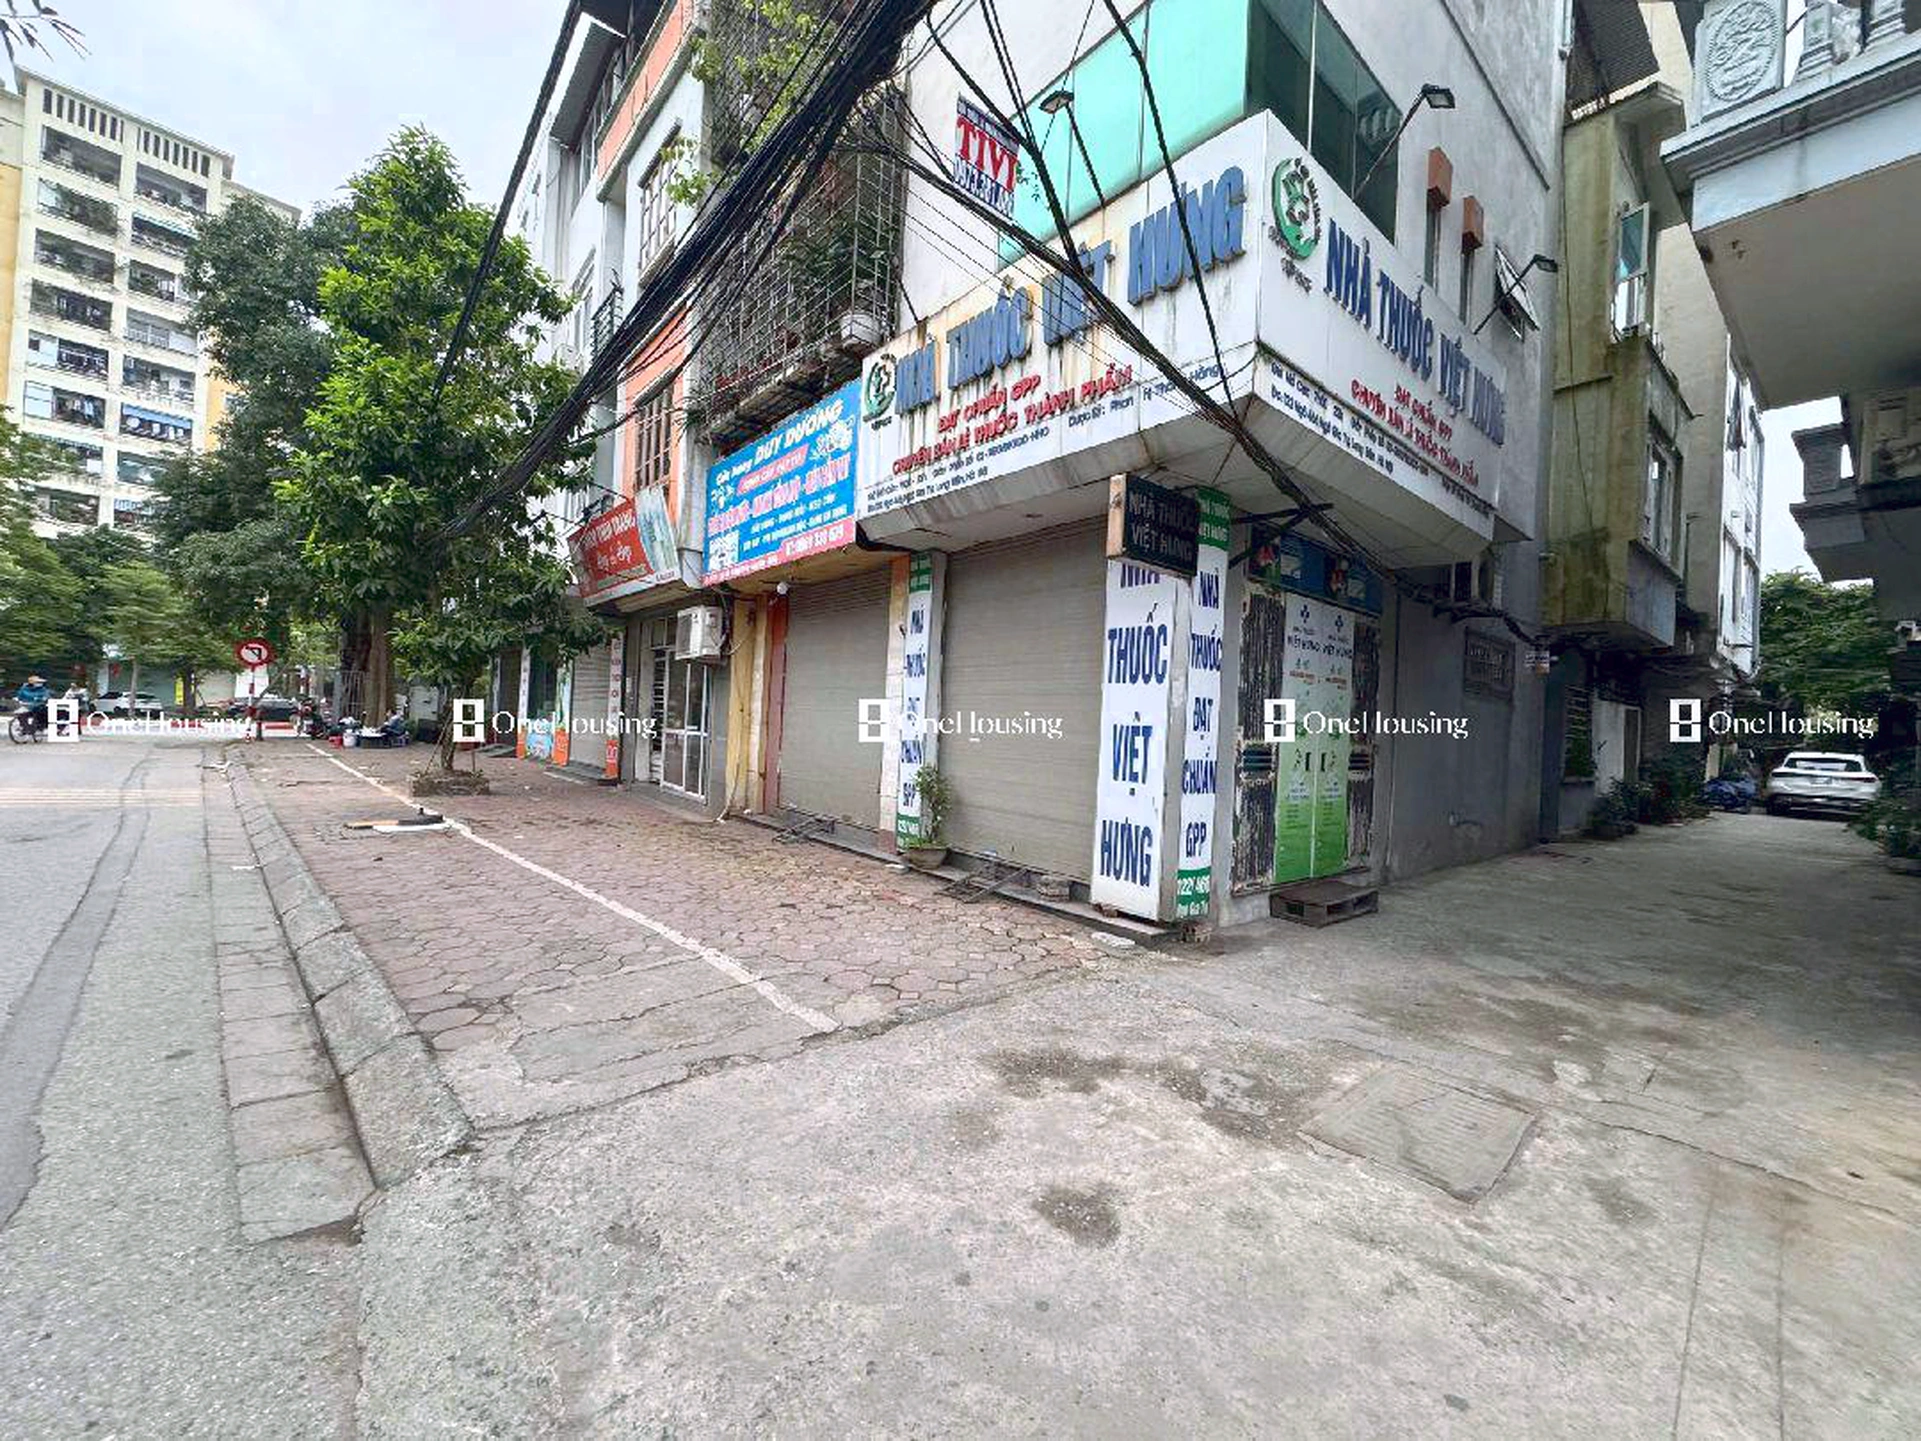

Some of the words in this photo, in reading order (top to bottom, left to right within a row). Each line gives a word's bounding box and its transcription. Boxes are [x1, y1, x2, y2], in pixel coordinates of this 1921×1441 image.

[956, 115, 1018, 193] TIVI
[895, 333, 936, 414] NHÀ
[946, 275, 1034, 390] THUỐC
[1128, 166, 1247, 306] HƯNG
[1323, 217, 1371, 329] NHÀ
[1376, 268, 1433, 382] THUỐC
[1438, 332, 1470, 417] VIỆT
[1011, 375, 1042, 405] GPP
[1024, 385, 1076, 428] THÀNH
[1198, 567, 1219, 610] NHÀ
[1108, 602, 1168, 685] THUỐC
[1191, 626, 1222, 672] THUỐC
[1193, 696, 1214, 742] ĐẠT
[1112, 711, 1153, 797] VIỆT
[1182, 746, 1217, 795] CHUẨN
[1100, 815, 1153, 887] HƯNG
[1186, 821, 1207, 858] GPP
